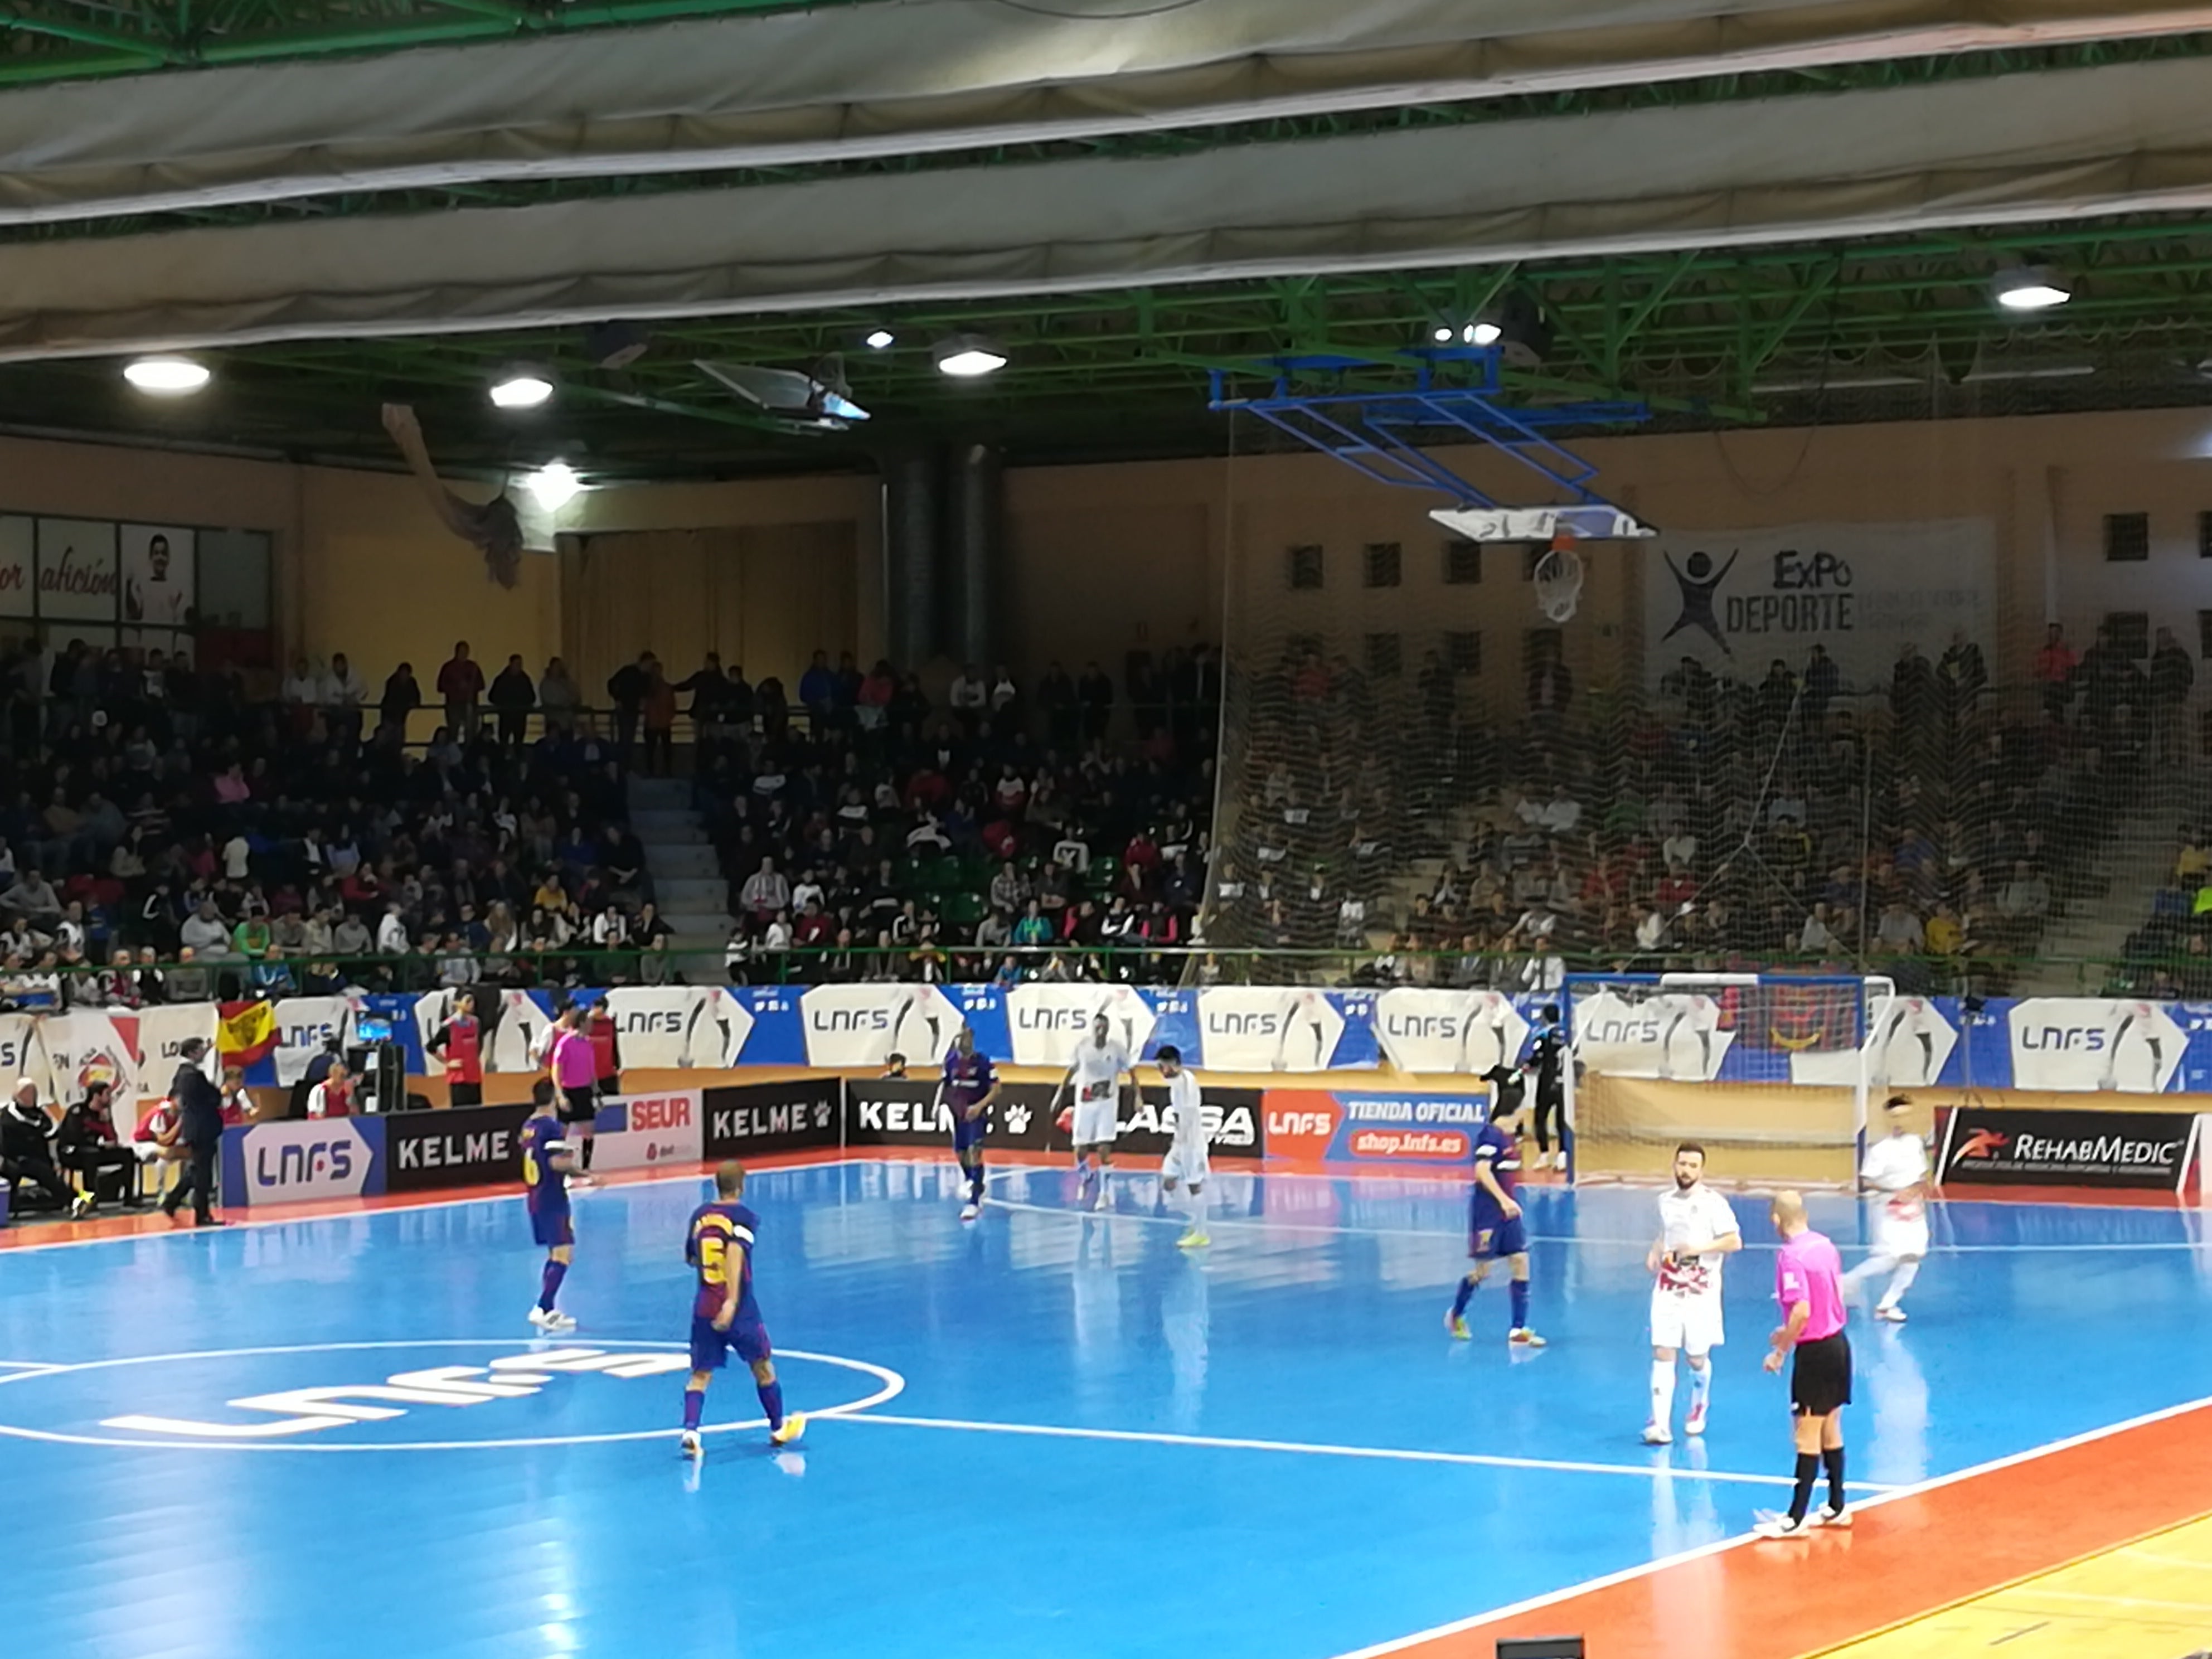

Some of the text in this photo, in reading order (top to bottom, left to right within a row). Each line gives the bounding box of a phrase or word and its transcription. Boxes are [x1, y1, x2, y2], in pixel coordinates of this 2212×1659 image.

[1728, 593, 1854, 633] DEPORTE
[632, 1097, 690, 1132] SEUR
[713, 1103, 808, 1139] KELME
[860, 1101, 994, 1134] KELM
[1348, 1101, 1485, 1123] TIENDA OFICIAL
[399, 1131, 510, 1169] KELME
[1356, 1132, 1462, 1154] shop.lnfs.es
